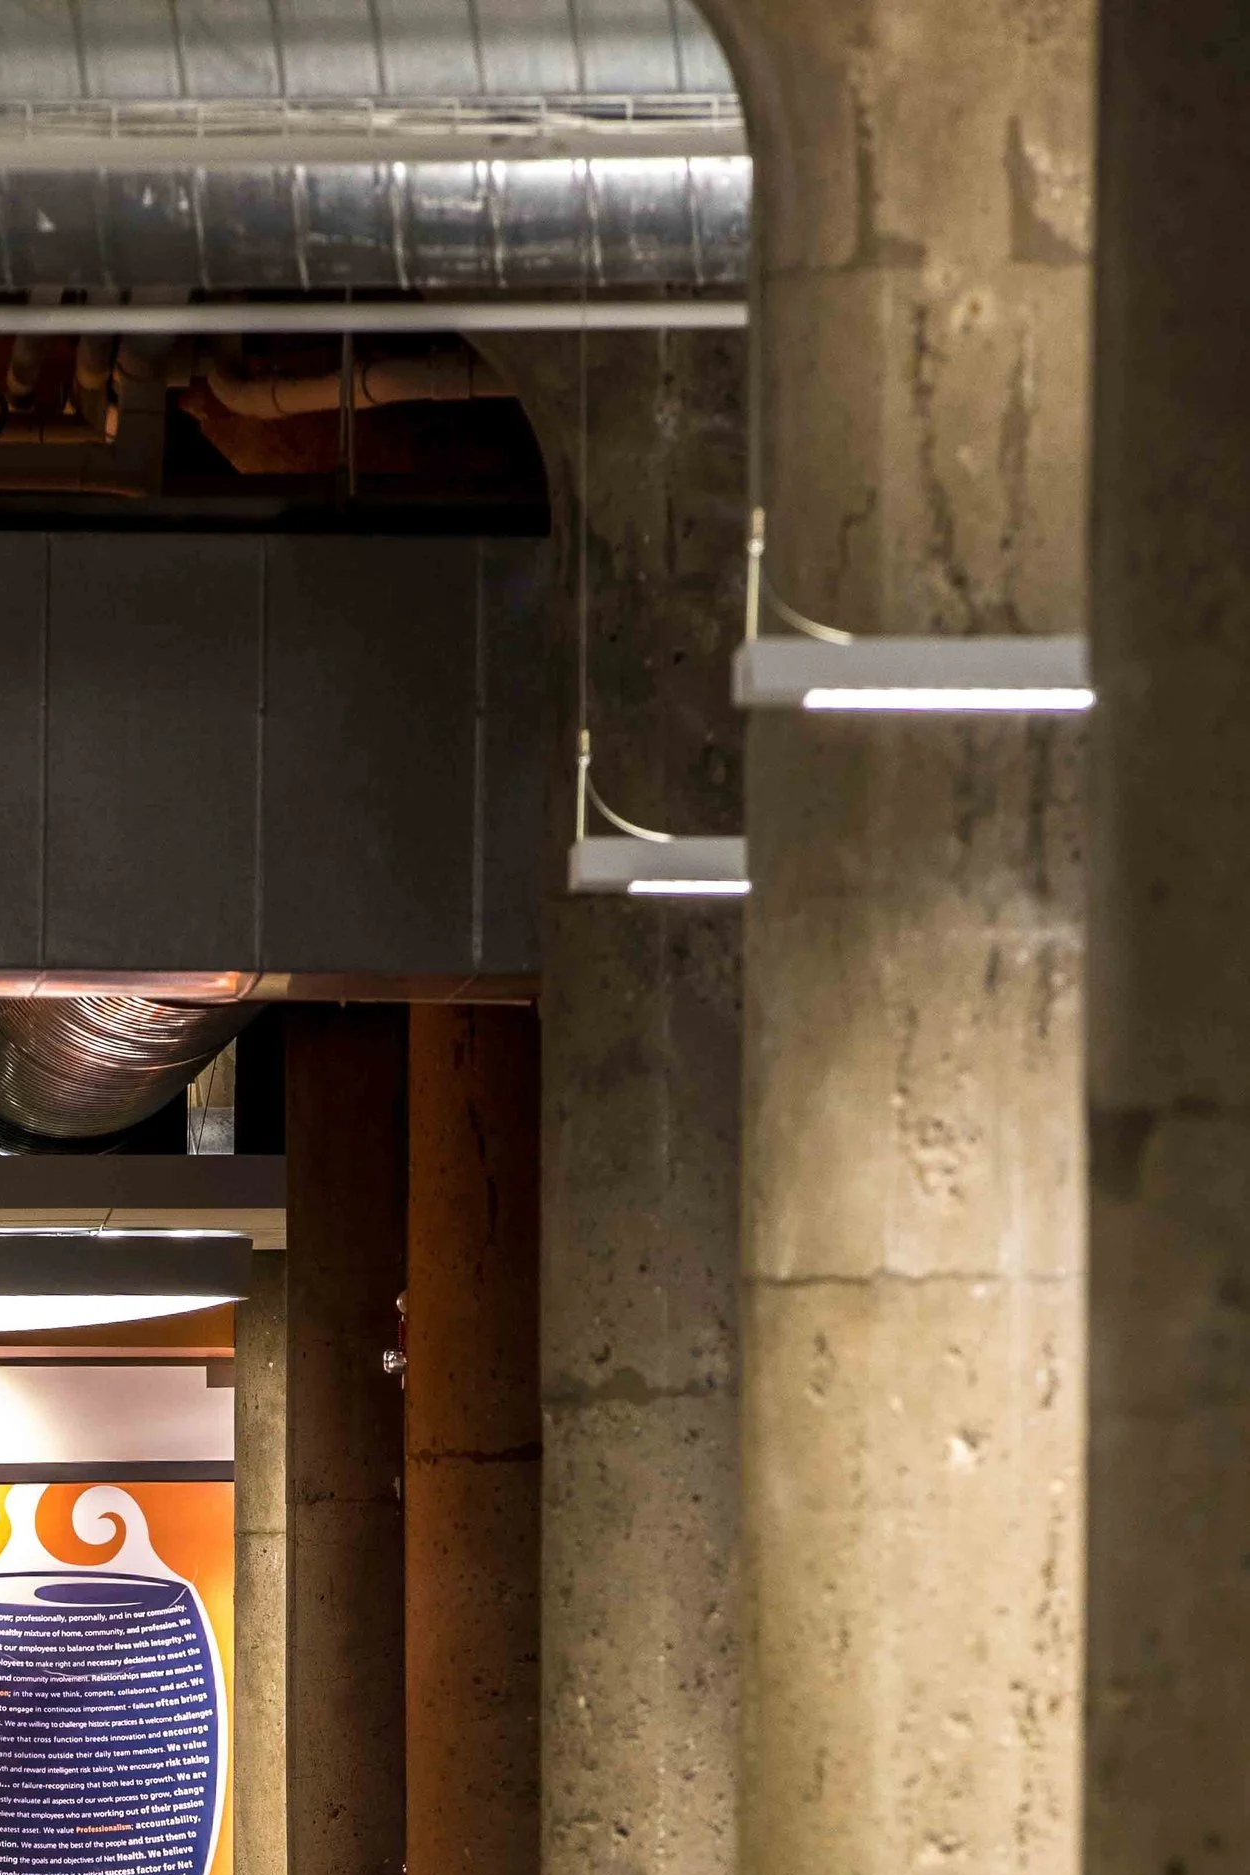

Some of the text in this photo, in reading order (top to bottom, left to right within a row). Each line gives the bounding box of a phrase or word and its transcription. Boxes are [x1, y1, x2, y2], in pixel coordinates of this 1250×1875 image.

[108, 1612, 123, 1620] and
[124, 1611, 132, 1619] in
[21, 1690, 33, 1698] the
[159, 1682, 175, 1692] and
[189, 1677, 204, 1686] We
[75, 1751, 92, 1759] their
[94, 1750, 112, 1758] daily
[132, 1747, 165, 1755] members.
[166, 1743, 181, 1752] We
[182, 1740, 207, 1750] value
[86, 1781, 101, 1789] that
[101, 1780, 119, 1788] both
[119, 1779, 135, 1787] lead
[144, 1775, 175, 1786] growth.
[176, 1772, 191, 1781] We
[192, 1771, 207, 1779] are
[31, 1857, 48, 1865] goals
[62, 1857, 94, 1865] objectives
[94, 1855, 102, 1863] of
[116, 1851, 147, 1861] Health.
[147, 1850, 162, 1858] We
[162, 1846, 193, 1856] believe
[136, 1865, 162, 1874] factor
[162, 1862, 176, 1871] for
[177, 1860, 193, 1869] Net
